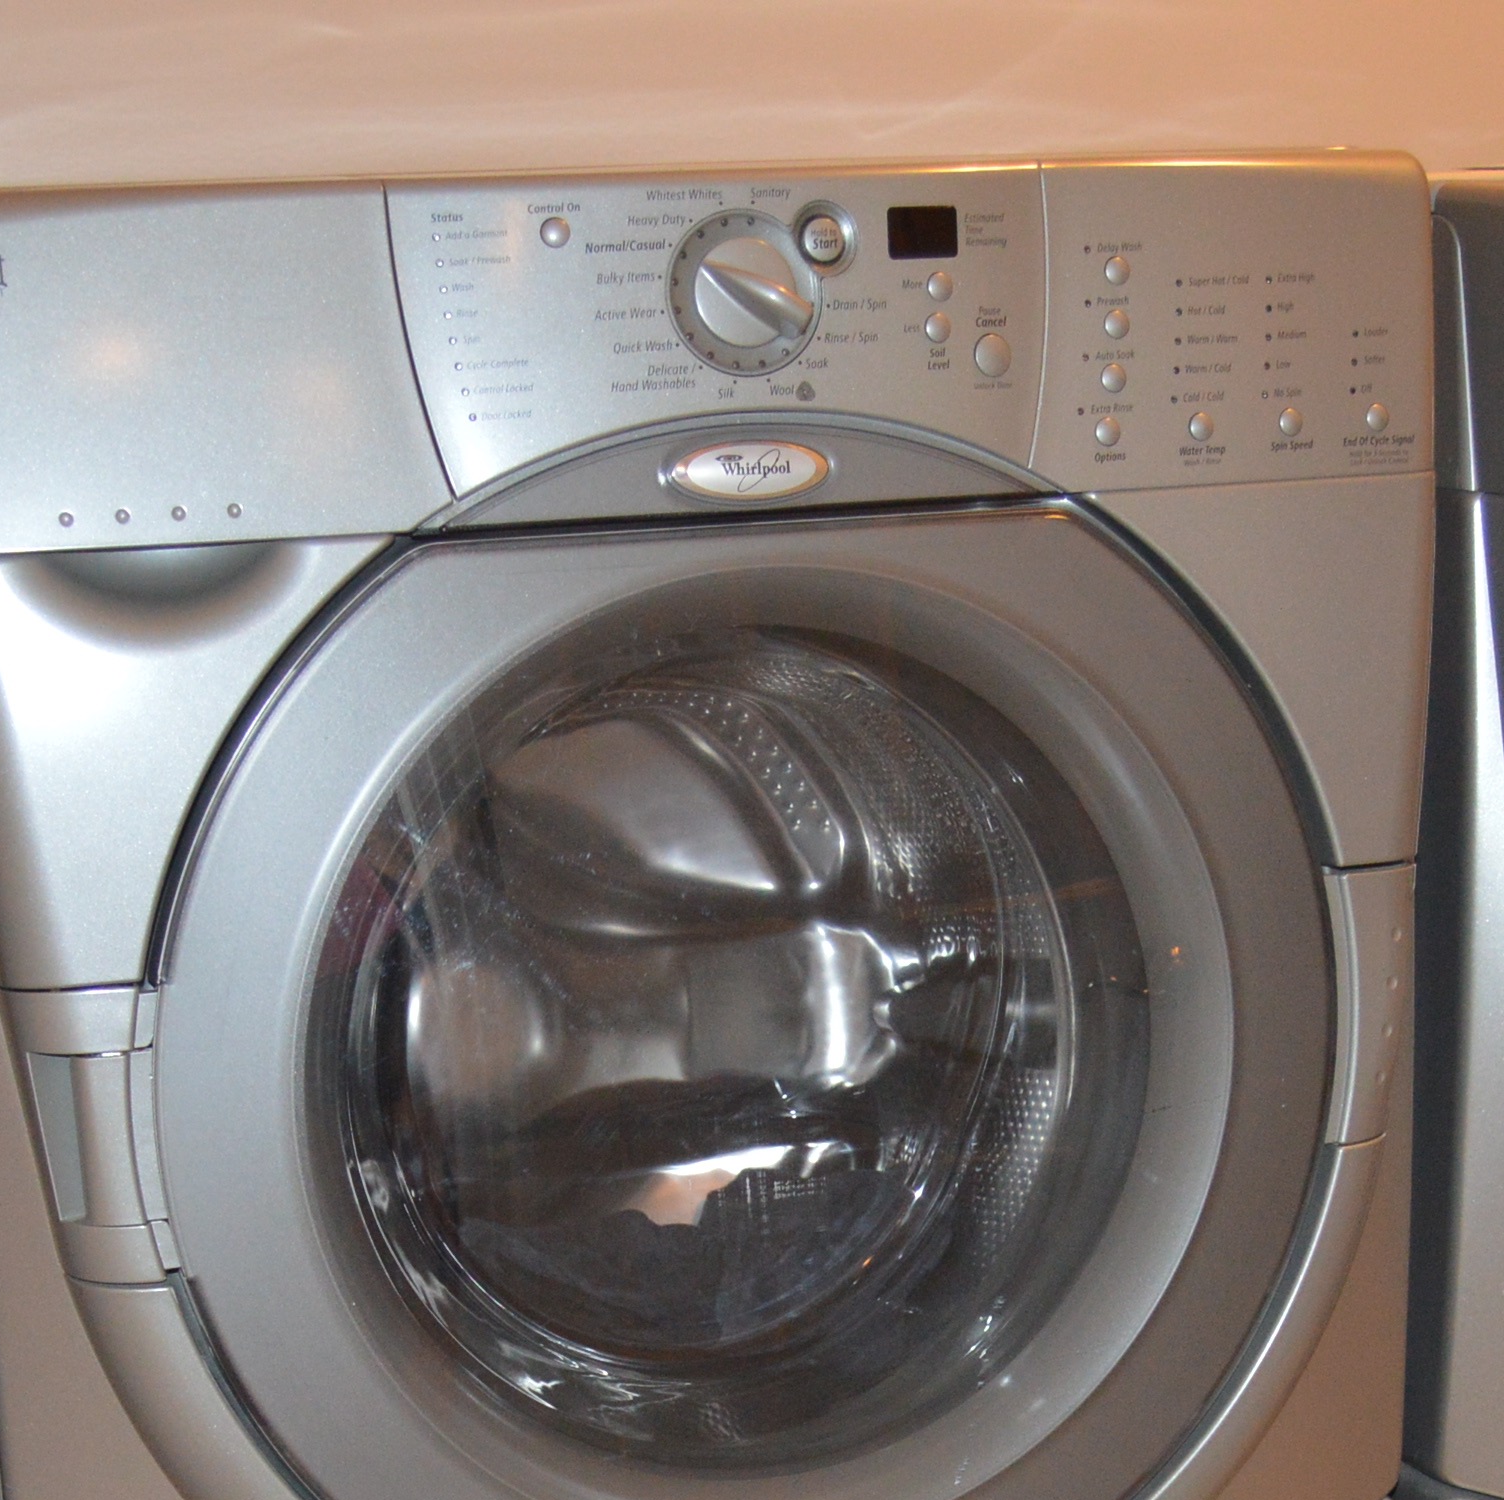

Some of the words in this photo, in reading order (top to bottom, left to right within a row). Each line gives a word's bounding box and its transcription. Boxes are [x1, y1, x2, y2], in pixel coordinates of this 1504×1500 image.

[647, 190, 685, 200] Whitest
[689, 189, 723, 200] Whites
[750, 188, 791, 200] Sanitary
[527, 202, 564, 214] Control
[567, 202, 581, 212] On
[431, 213, 464, 223] Status
[627, 216, 659, 227] Heavy
[662, 214, 686, 227] Duty
[585, 239, 666, 254] Normal/Casual
[812, 238, 838, 250] Start
[596, 272, 624, 286] Bulky
[627, 271, 655, 283] Items
[833, 300, 858, 310] Drain
[867, 299, 887, 312] Spin
[595, 309, 625, 321] Active
[630, 308, 656, 319] Wear
[976, 316, 1007, 328] Cancel
[824, 333, 850, 343] Rinse
[858, 332, 879, 344] Spin
[613, 341, 641, 354] Quick
[645, 340, 673, 352] Wash
[929, 347, 946, 358] Soil
[805, 358, 829, 369] Soak
[927, 359, 950, 371] Level
[647, 365, 688, 376] Delicate
[611, 381, 638, 392] Hand
[641, 378, 696, 391] Washables
[770, 384, 795, 396] Wool
[718, 387, 735, 399] Silk
[1271, 441, 1288, 453] Spin
[1290, 439, 1314, 452] Speed
[1343, 436, 1357, 447] End
[1391, 434, 1415, 446] Signal
[1179, 446, 1203, 456] Water
[1206, 445, 1226, 456] Temp
[1094, 452, 1126, 464] Options
[721, 460, 791, 478] Whirlpool
